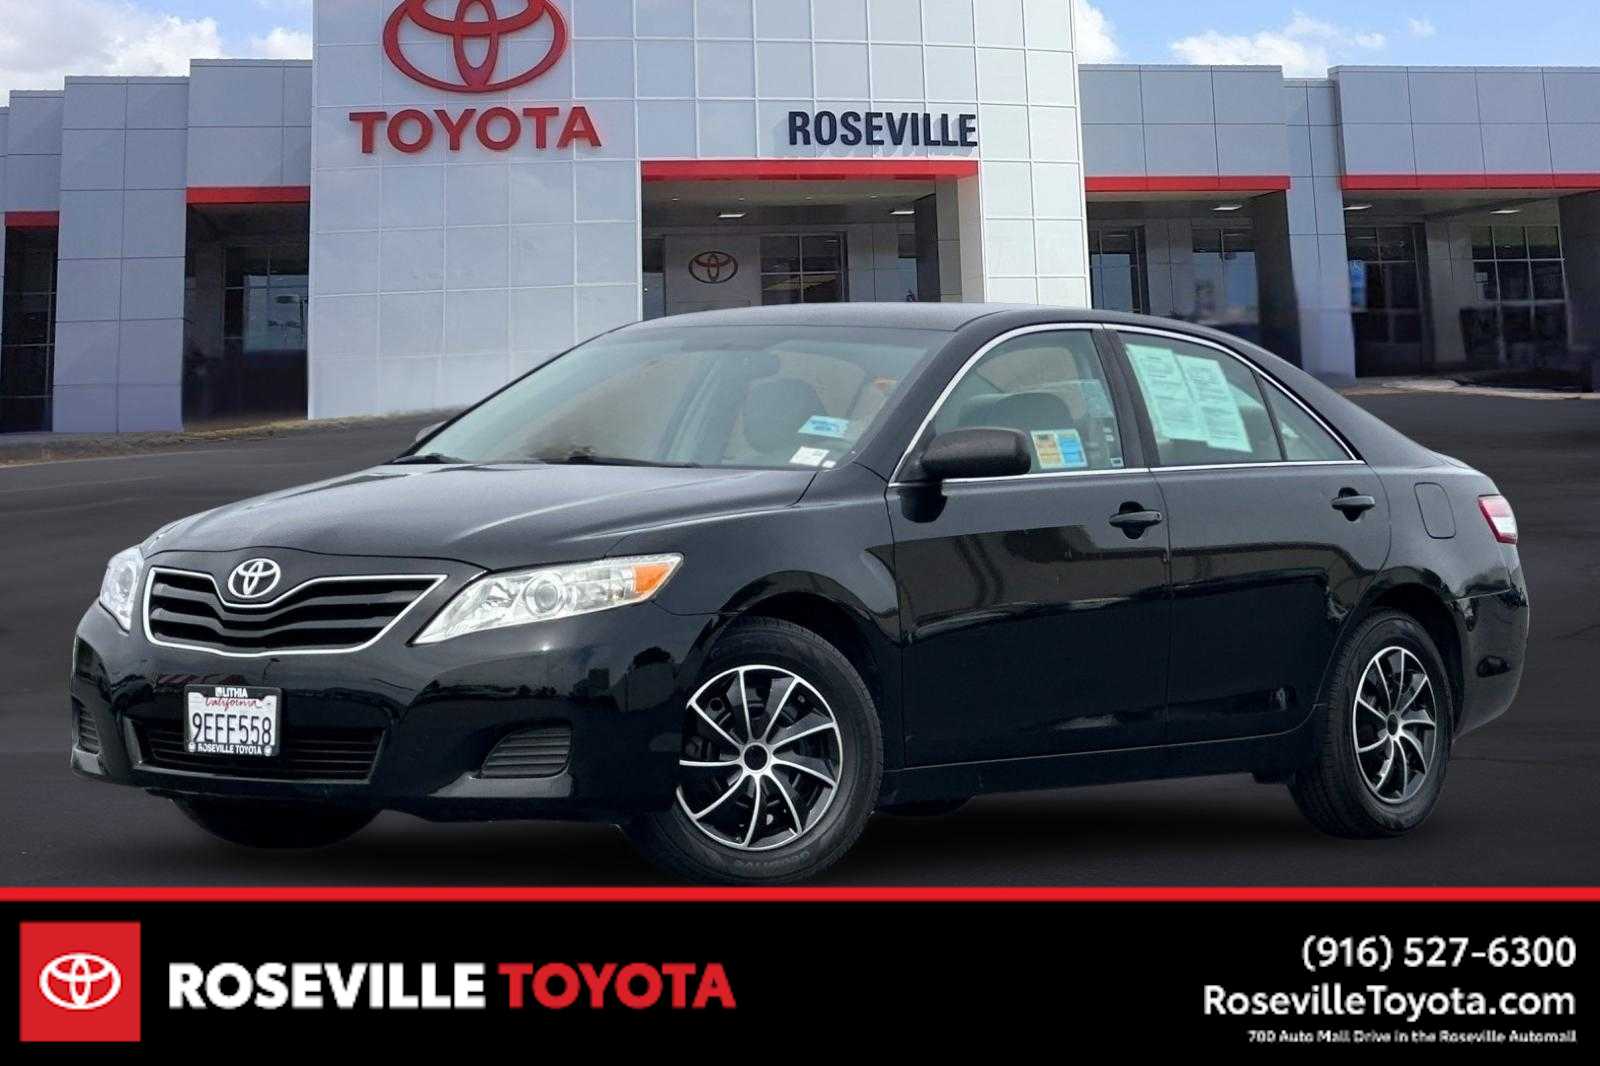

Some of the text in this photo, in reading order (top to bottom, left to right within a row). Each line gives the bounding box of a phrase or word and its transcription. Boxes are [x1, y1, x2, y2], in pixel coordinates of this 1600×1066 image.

[349, 106, 602, 154] TOYOTA
[788, 111, 977, 147] ROSEVILLE
[222, 687, 248, 698] LITHIA
[192, 712, 272, 746] 9EFF558
[197, 744, 262, 755] ROSEVILLE TOYOTA
